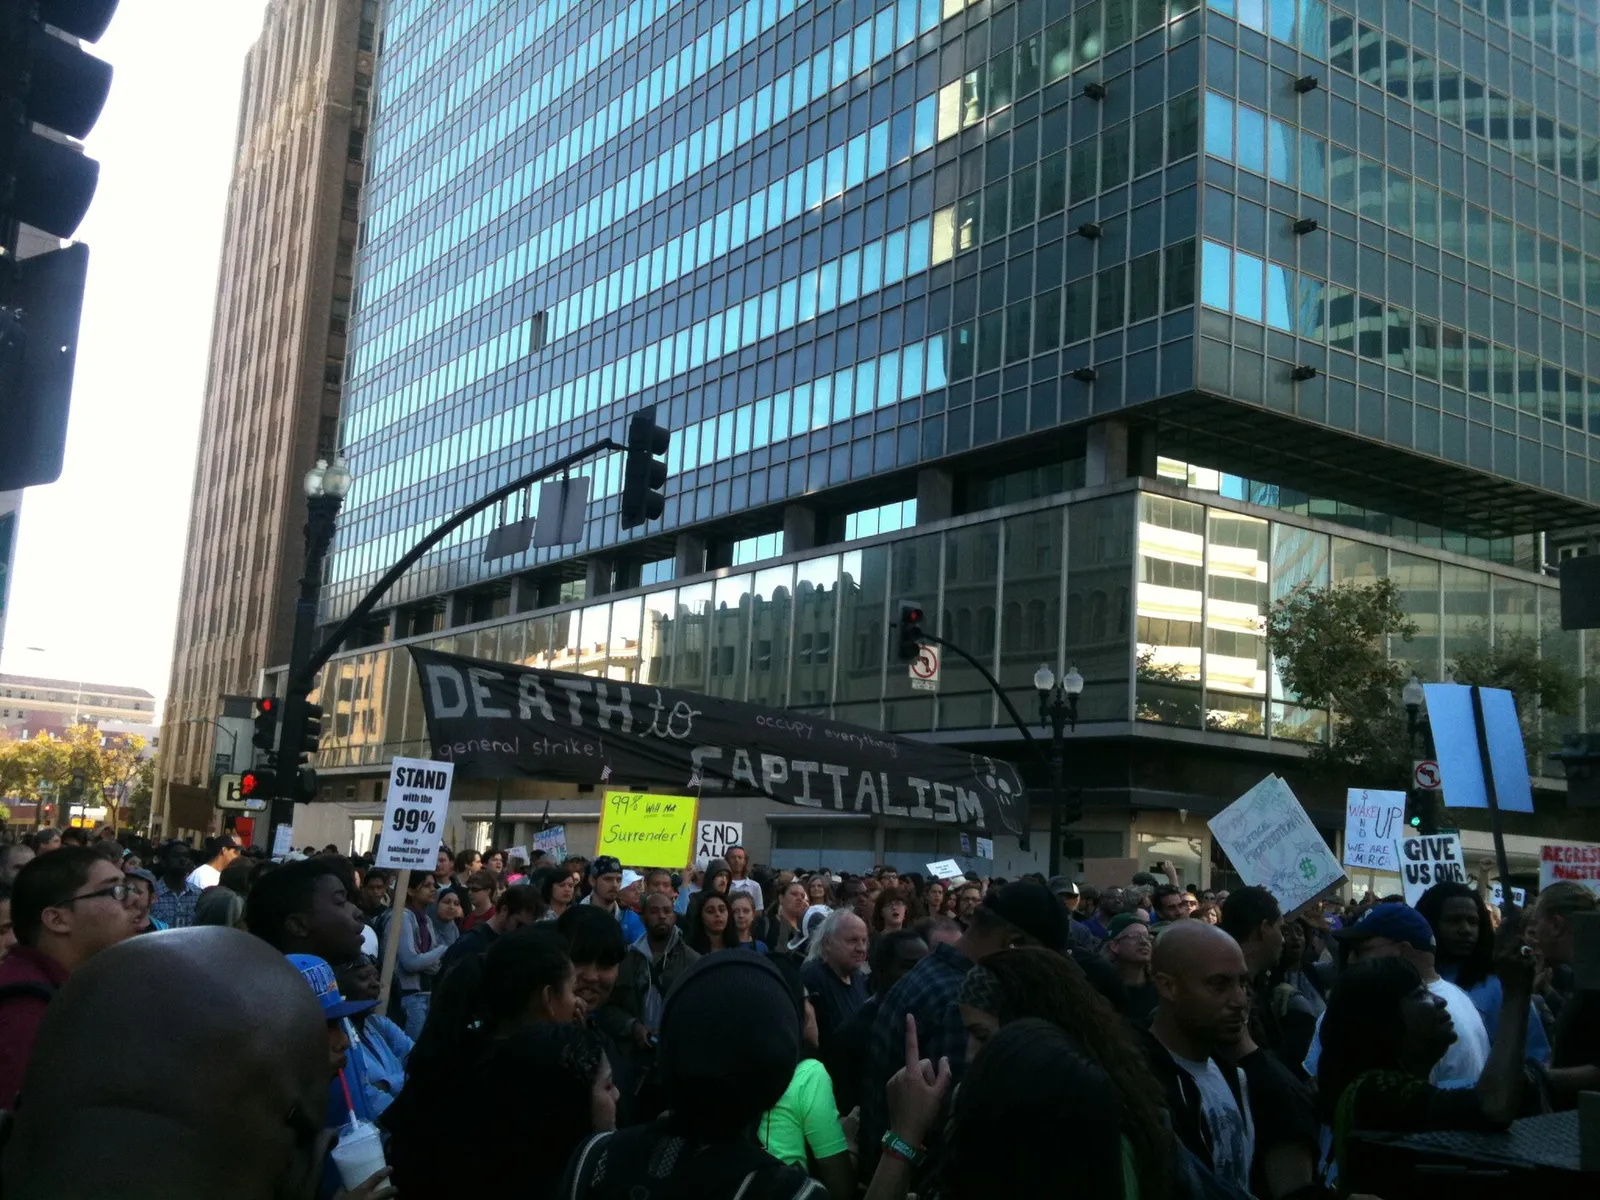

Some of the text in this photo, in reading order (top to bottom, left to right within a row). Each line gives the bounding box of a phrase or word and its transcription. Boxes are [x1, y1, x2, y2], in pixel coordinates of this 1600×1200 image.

[425, 664, 703, 739] DEATH to
[756, 714, 814, 739] occupy
[438, 736, 605, 763] general strike!
[395, 766, 447, 791] STAND
[690, 746, 986, 828] CAPITALISM
[402, 792, 433, 804] with the
[611, 795, 643, 815] 99%
[646, 802, 661, 814] Will
[391, 807, 436, 834] 99%
[603, 822, 687, 843] Surrender!
[1349, 804, 1403, 839] WAKE UP
[701, 823, 740, 845] END
[1347, 843, 1390, 855] WE ARE
[1403, 837, 1455, 861] GIVE
[1405, 862, 1464, 885] US OUR
